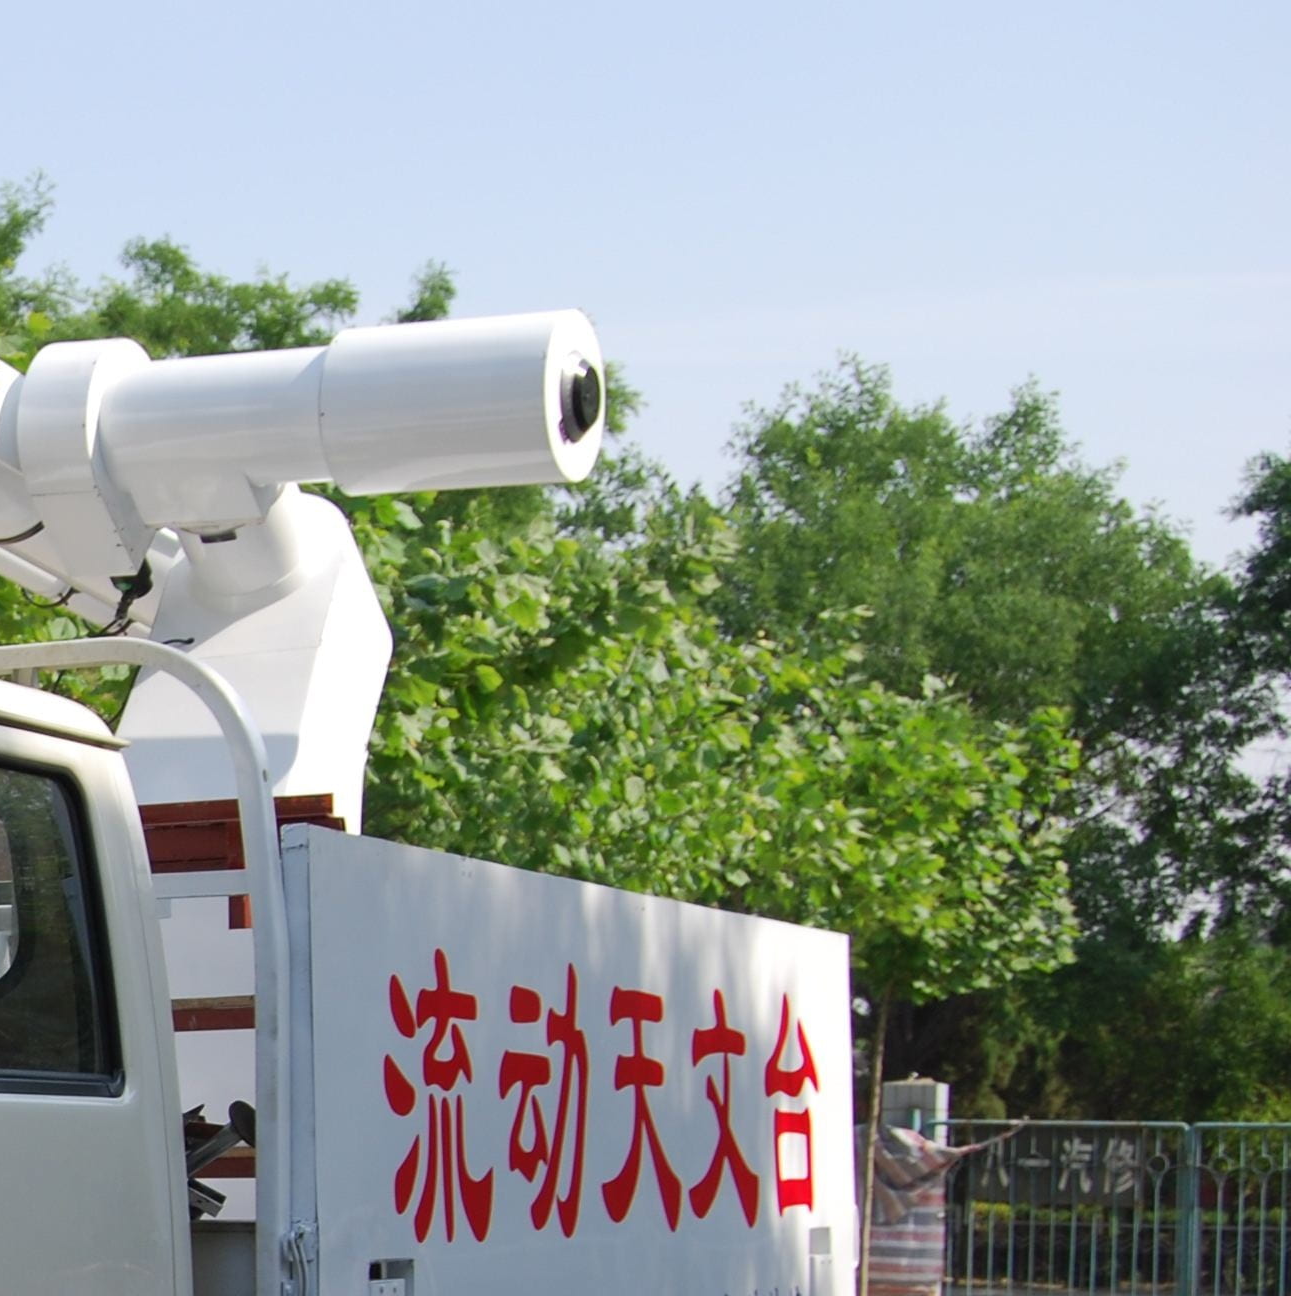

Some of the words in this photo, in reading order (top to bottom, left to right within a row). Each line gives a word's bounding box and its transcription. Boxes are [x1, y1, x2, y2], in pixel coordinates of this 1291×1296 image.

[383, 948, 819, 1243] 流动天文台
